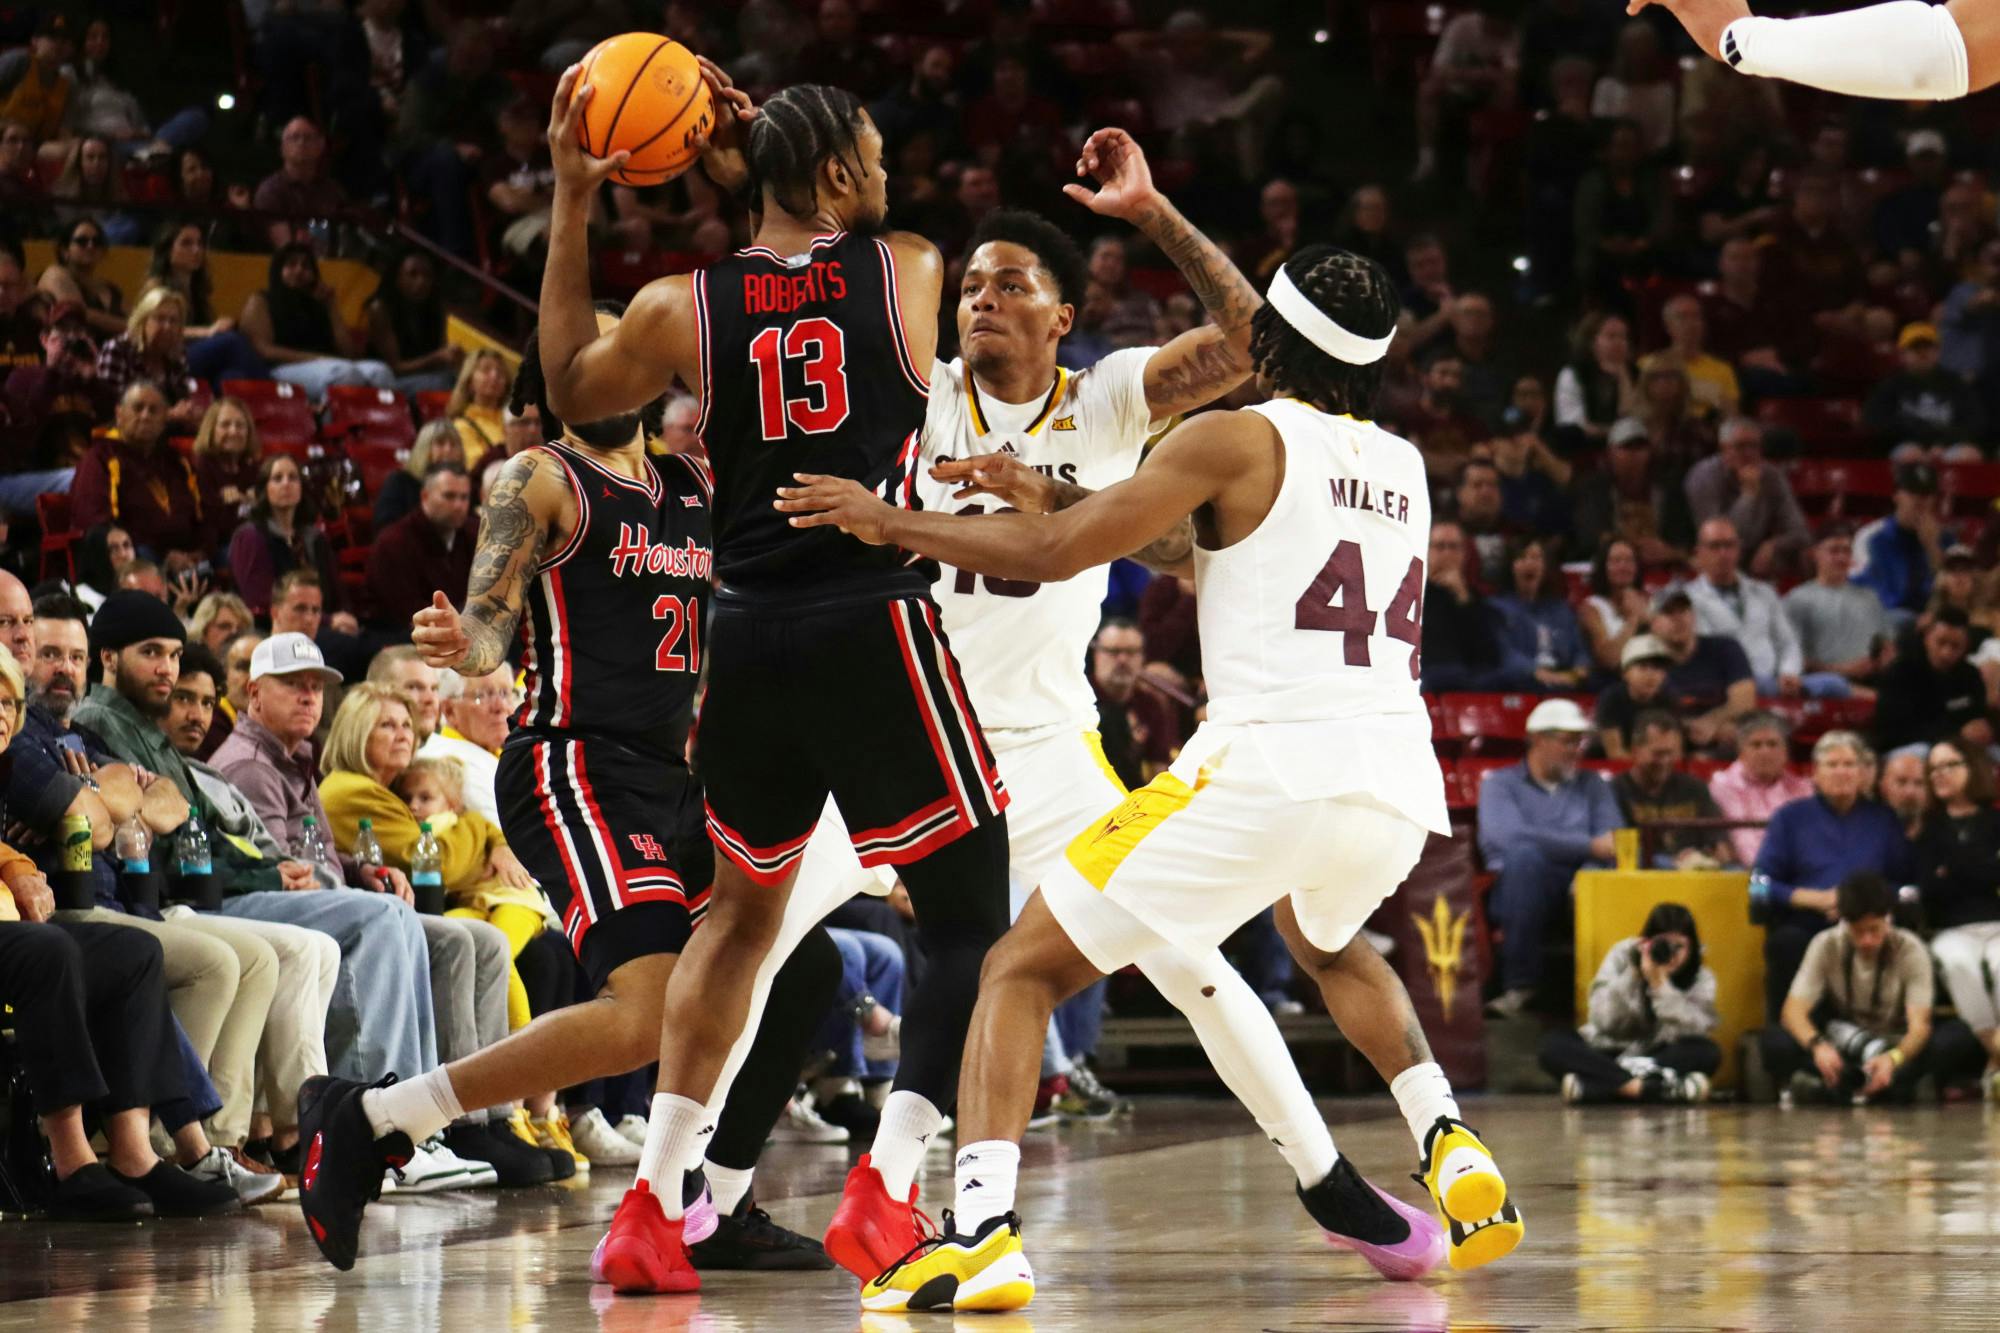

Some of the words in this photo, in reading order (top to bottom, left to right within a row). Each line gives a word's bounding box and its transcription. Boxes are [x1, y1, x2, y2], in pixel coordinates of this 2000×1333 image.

[750, 316, 850, 441] 13
[652, 594, 699, 674] 21
[1294, 539, 1424, 681] 44
